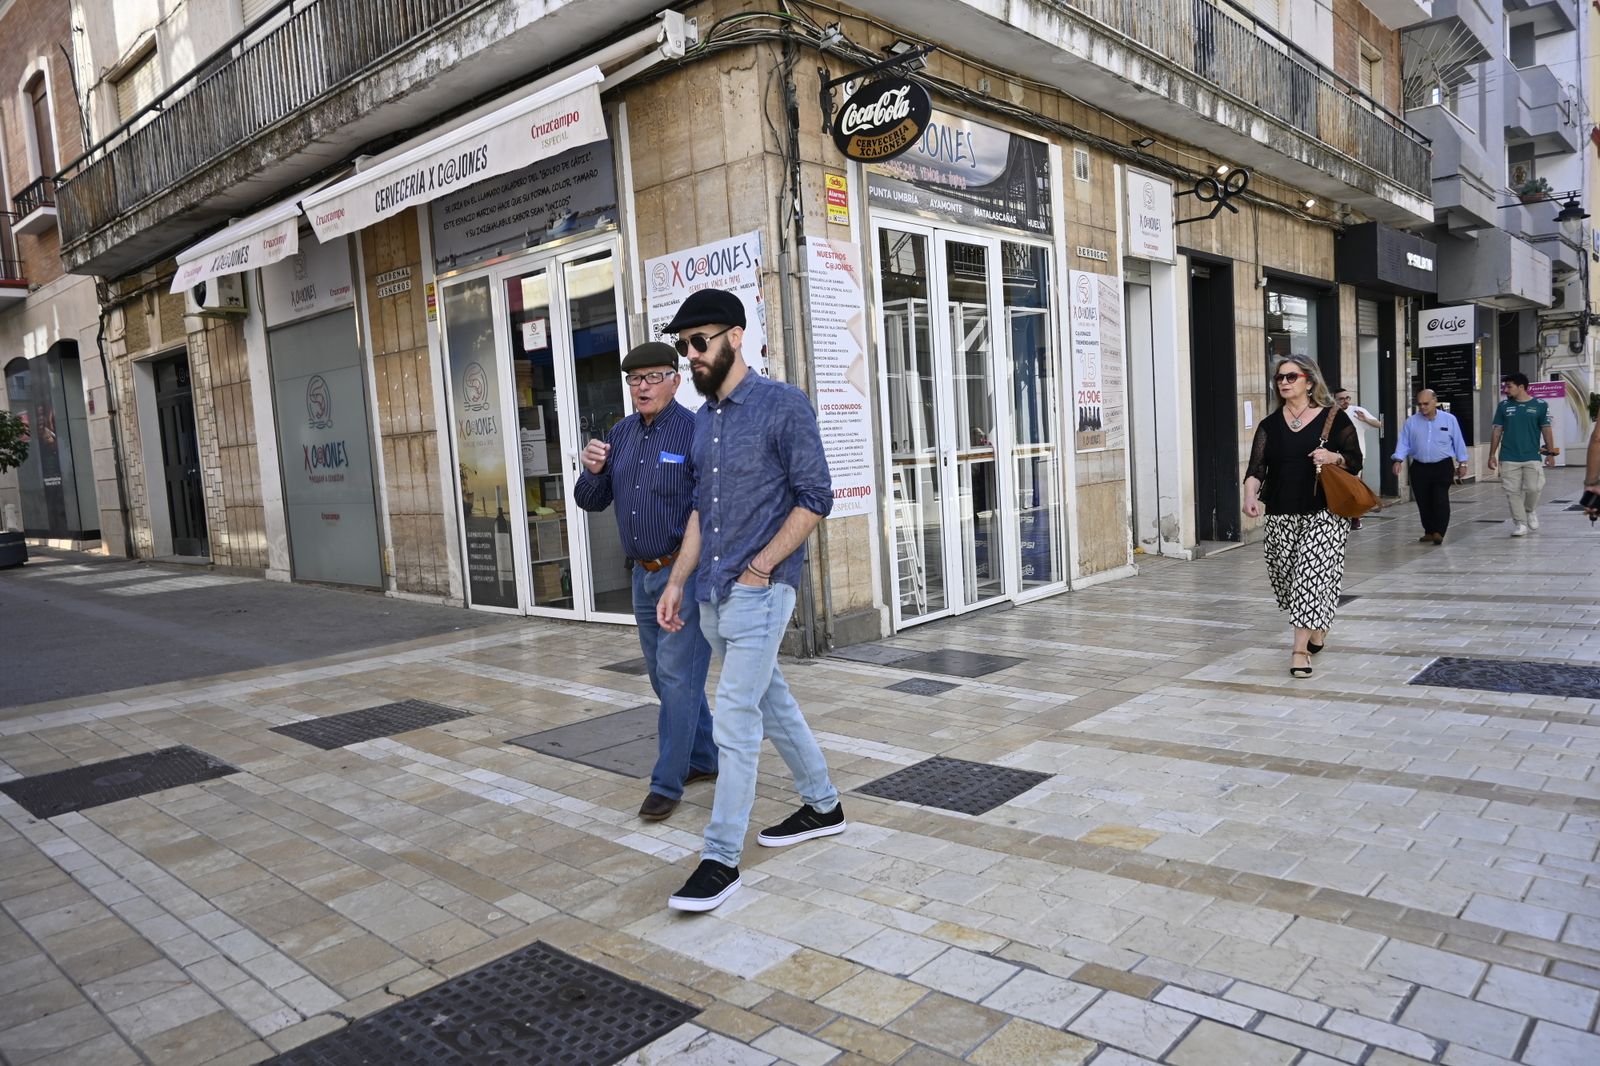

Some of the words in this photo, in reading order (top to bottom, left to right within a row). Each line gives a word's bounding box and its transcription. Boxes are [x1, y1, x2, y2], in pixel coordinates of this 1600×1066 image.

[531, 110, 580, 140] Cruzcampo
[856, 124, 909, 148] CERVECERIA
[541, 130, 569, 149] ESPECIAL
[859, 135, 907, 157] XCAJONES
[918, 122, 977, 169] JONES
[375, 172, 426, 214] CERVECERÍA
[428, 165, 436, 194] X
[437, 143, 488, 185] C@JONES
[869, 185, 893, 200] PUNTA
[893, 189, 919, 205] UMBRÍA
[929, 199, 963, 214] AYAMONTE
[974, 207, 1017, 225] MATALASCAÑAS
[1027, 218, 1047, 231] HUELVA
[210, 256, 219, 273] X
[671, 260, 685, 288] X
[685, 242, 752, 282] C@JONES
[816, 251, 847, 261] NUESTROS
[377, 281, 410, 297] CISNEROS
[459, 419, 466, 441] X
[465, 415, 497, 437] C@JONES
[303, 444, 312, 475] X
[311, 440, 349, 469] C@JONES
[831, 485, 871, 500] uzcampo
[833, 501, 862, 512] ESPECIAL
